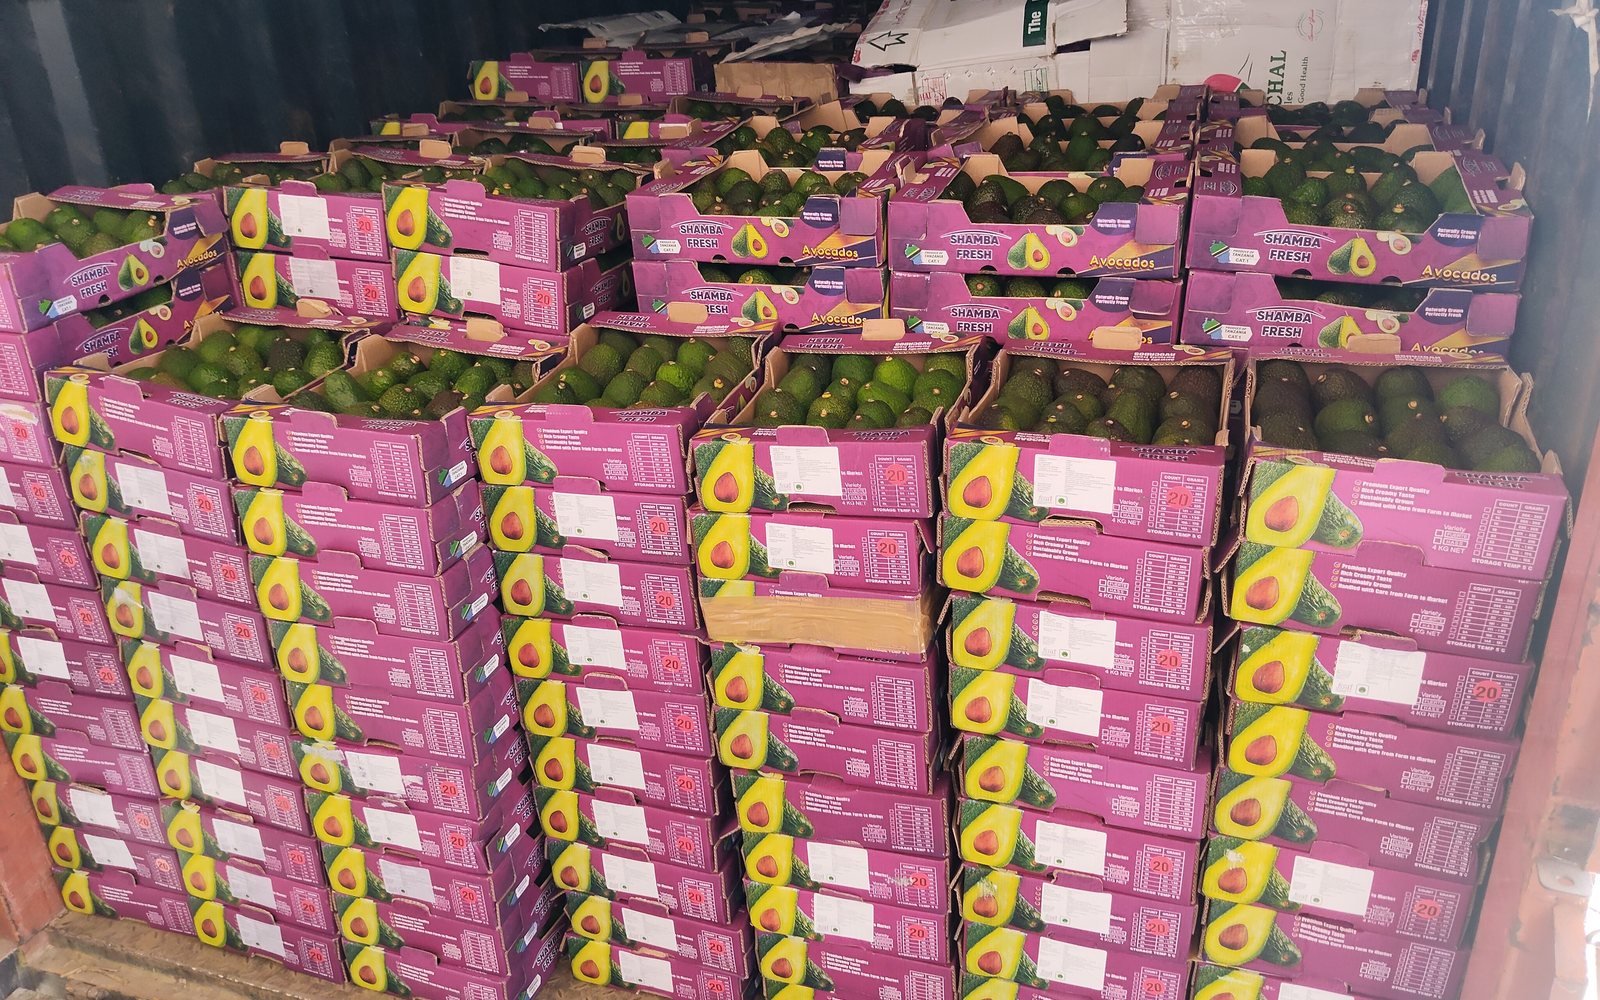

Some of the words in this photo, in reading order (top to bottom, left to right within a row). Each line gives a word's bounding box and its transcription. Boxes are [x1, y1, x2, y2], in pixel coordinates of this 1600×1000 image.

[1028, 11, 1041, 34] The
[1299, 56, 1309, 82] Health
[359, 221, 370, 231] 20
[680, 225, 723, 235] SHAMBA
[687, 238, 718, 249] FRESH
[950, 235, 999, 245] SHAMBA
[1264, 234, 1321, 248] SHAMBA
[802, 245, 858, 259] Avocados
[956, 250, 992, 260] FRESH
[1269, 250, 1311, 262] FRESH
[177, 249, 218, 268] Avocados
[1090, 255, 1155, 270] Avocados
[71, 267, 109, 286] SHAMBA
[1422, 265, 1497, 283] Avocados
[80, 282, 108, 299] FRESH
[365, 288, 377, 298] 20
[537, 293, 550, 304] 20
[690, 291, 733, 301] SHAMBA
[704, 304, 728, 314] RESH
[951, 309, 1000, 319] SHAMBA
[812, 313, 867, 326] Avocados
[1257, 311, 1312, 323] SHAMBA
[957, 323, 992, 332] FRESH
[1262, 326, 1302, 337] FRESH
[84, 332, 121, 353] SHAMBA
[15, 428, 27, 438] 20
[1131, 447, 1198, 456] SHAMBA
[888, 471, 904, 481] 20
[1455, 472, 1531, 483] SHAMBA
[1363, 481, 1388, 490] Premium
[1389, 484, 1408, 492] Export
[33, 486, 44, 498] 20
[1375, 489, 1395, 498] Creamy
[200, 500, 210, 508] 20
[1167, 492, 1188, 506] 20
[1360, 494, 1394, 503] Sustainably
[1395, 497, 1414, 505] Grown
[1359, 500, 1382, 508] Handled
[1451, 511, 1472, 519] Market
[652, 522, 665, 532] 20
[1444, 524, 1466, 532] Variety
[880, 543, 896, 554] 20
[62, 554, 73, 565] 20
[1472, 558, 1502, 567] STORAGE
[1504, 561, 1522, 569] TEMP
[223, 569, 235, 578] 20
[1342, 563, 1367, 572] Premium
[1387, 570, 1407, 578] Quality
[1354, 572, 1376, 580] Creamy
[1339, 577, 1372, 586] Sustainably
[1338, 583, 1360, 591] Handled
[1427, 596, 1448, 604] Market
[658, 596, 671, 606] 20
[80, 612, 92, 622] 20
[1421, 608, 1441, 616] Variety
[237, 627, 250, 637] 20
[1447, 640, 1476, 649] STORAGE
[666, 659, 678, 669] 20
[1160, 655, 1177, 666] 20
[101, 671, 113, 681] 20
[254, 691, 266, 700] 20
[1476, 686, 1497, 698] 20
[678, 720, 691, 729] 20
[1152, 722, 1170, 732] 20
[679, 779, 692, 789] 20
[443, 785, 456, 794] 20
[451, 837, 464, 846] 20
[679, 841, 691, 851] 20
[291, 855, 303, 864] 20
[1153, 861, 1168, 872] 20
[912, 877, 926, 886] 20
[462, 891, 474, 900] 20
[688, 892, 701, 902] 20
[303, 904, 315, 914] 20
[1417, 904, 1437, 916] 20
[910, 928, 924, 938] 20
[1149, 924, 1165, 933] 20
[710, 943, 723, 952] 20
[310, 952, 322, 961] 20
[709, 983, 722, 992] 20
[1146, 983, 1161, 993] 20
